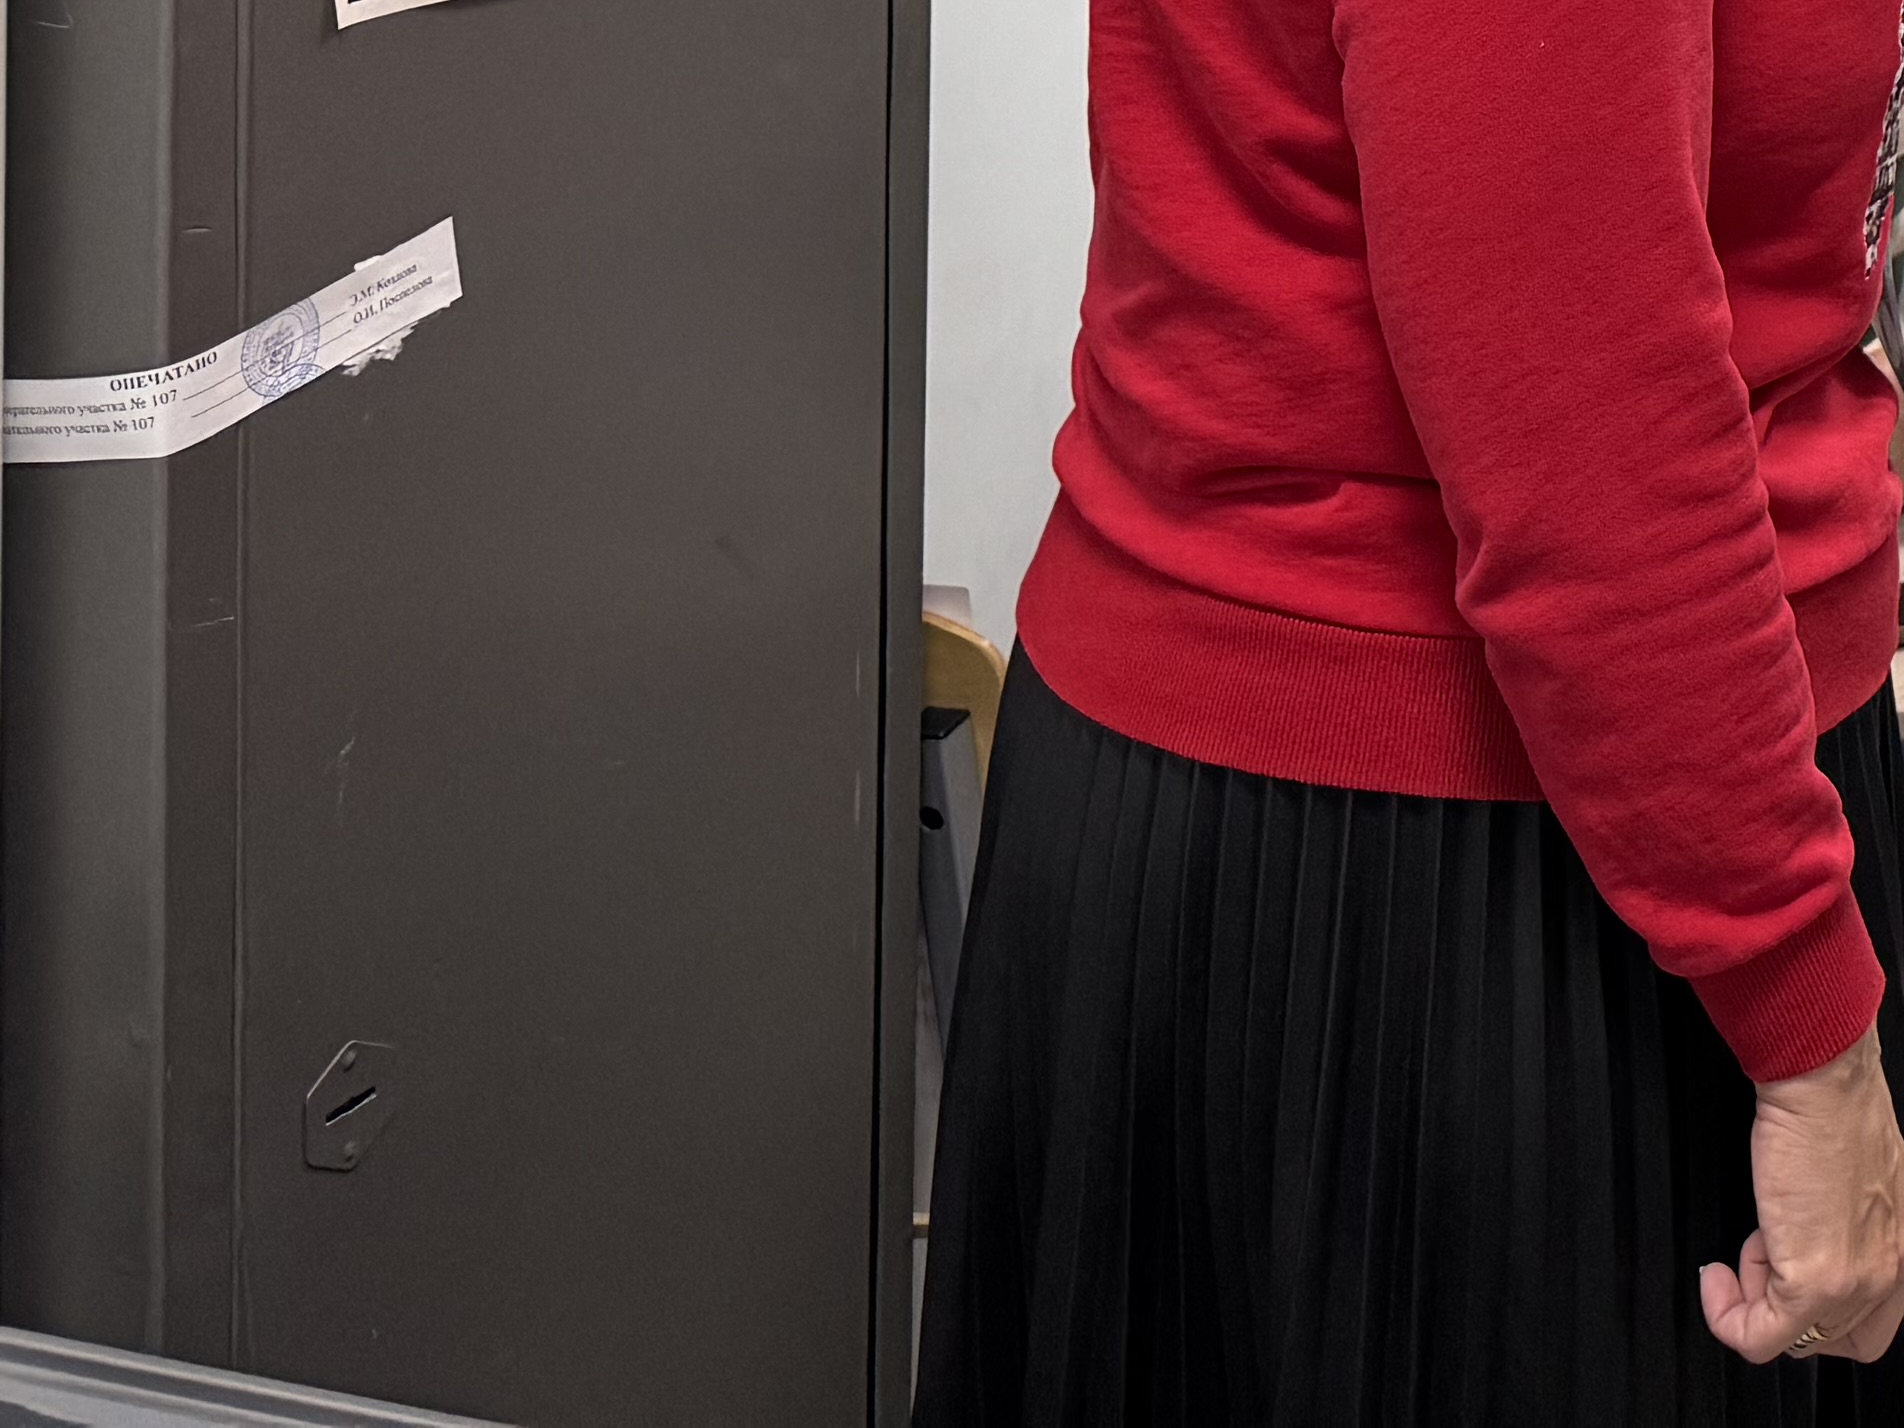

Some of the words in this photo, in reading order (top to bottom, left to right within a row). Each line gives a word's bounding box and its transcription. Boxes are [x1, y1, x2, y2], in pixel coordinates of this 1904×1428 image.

[110, 351, 218, 392] ОПЕЧАТАНО
[77, 402, 126, 417] участка
[130, 398, 146, 410] №
[152, 390, 177, 407] 107
[65, 422, 110, 437] участка
[113, 419, 128, 432] №
[132, 417, 155, 431] 107
